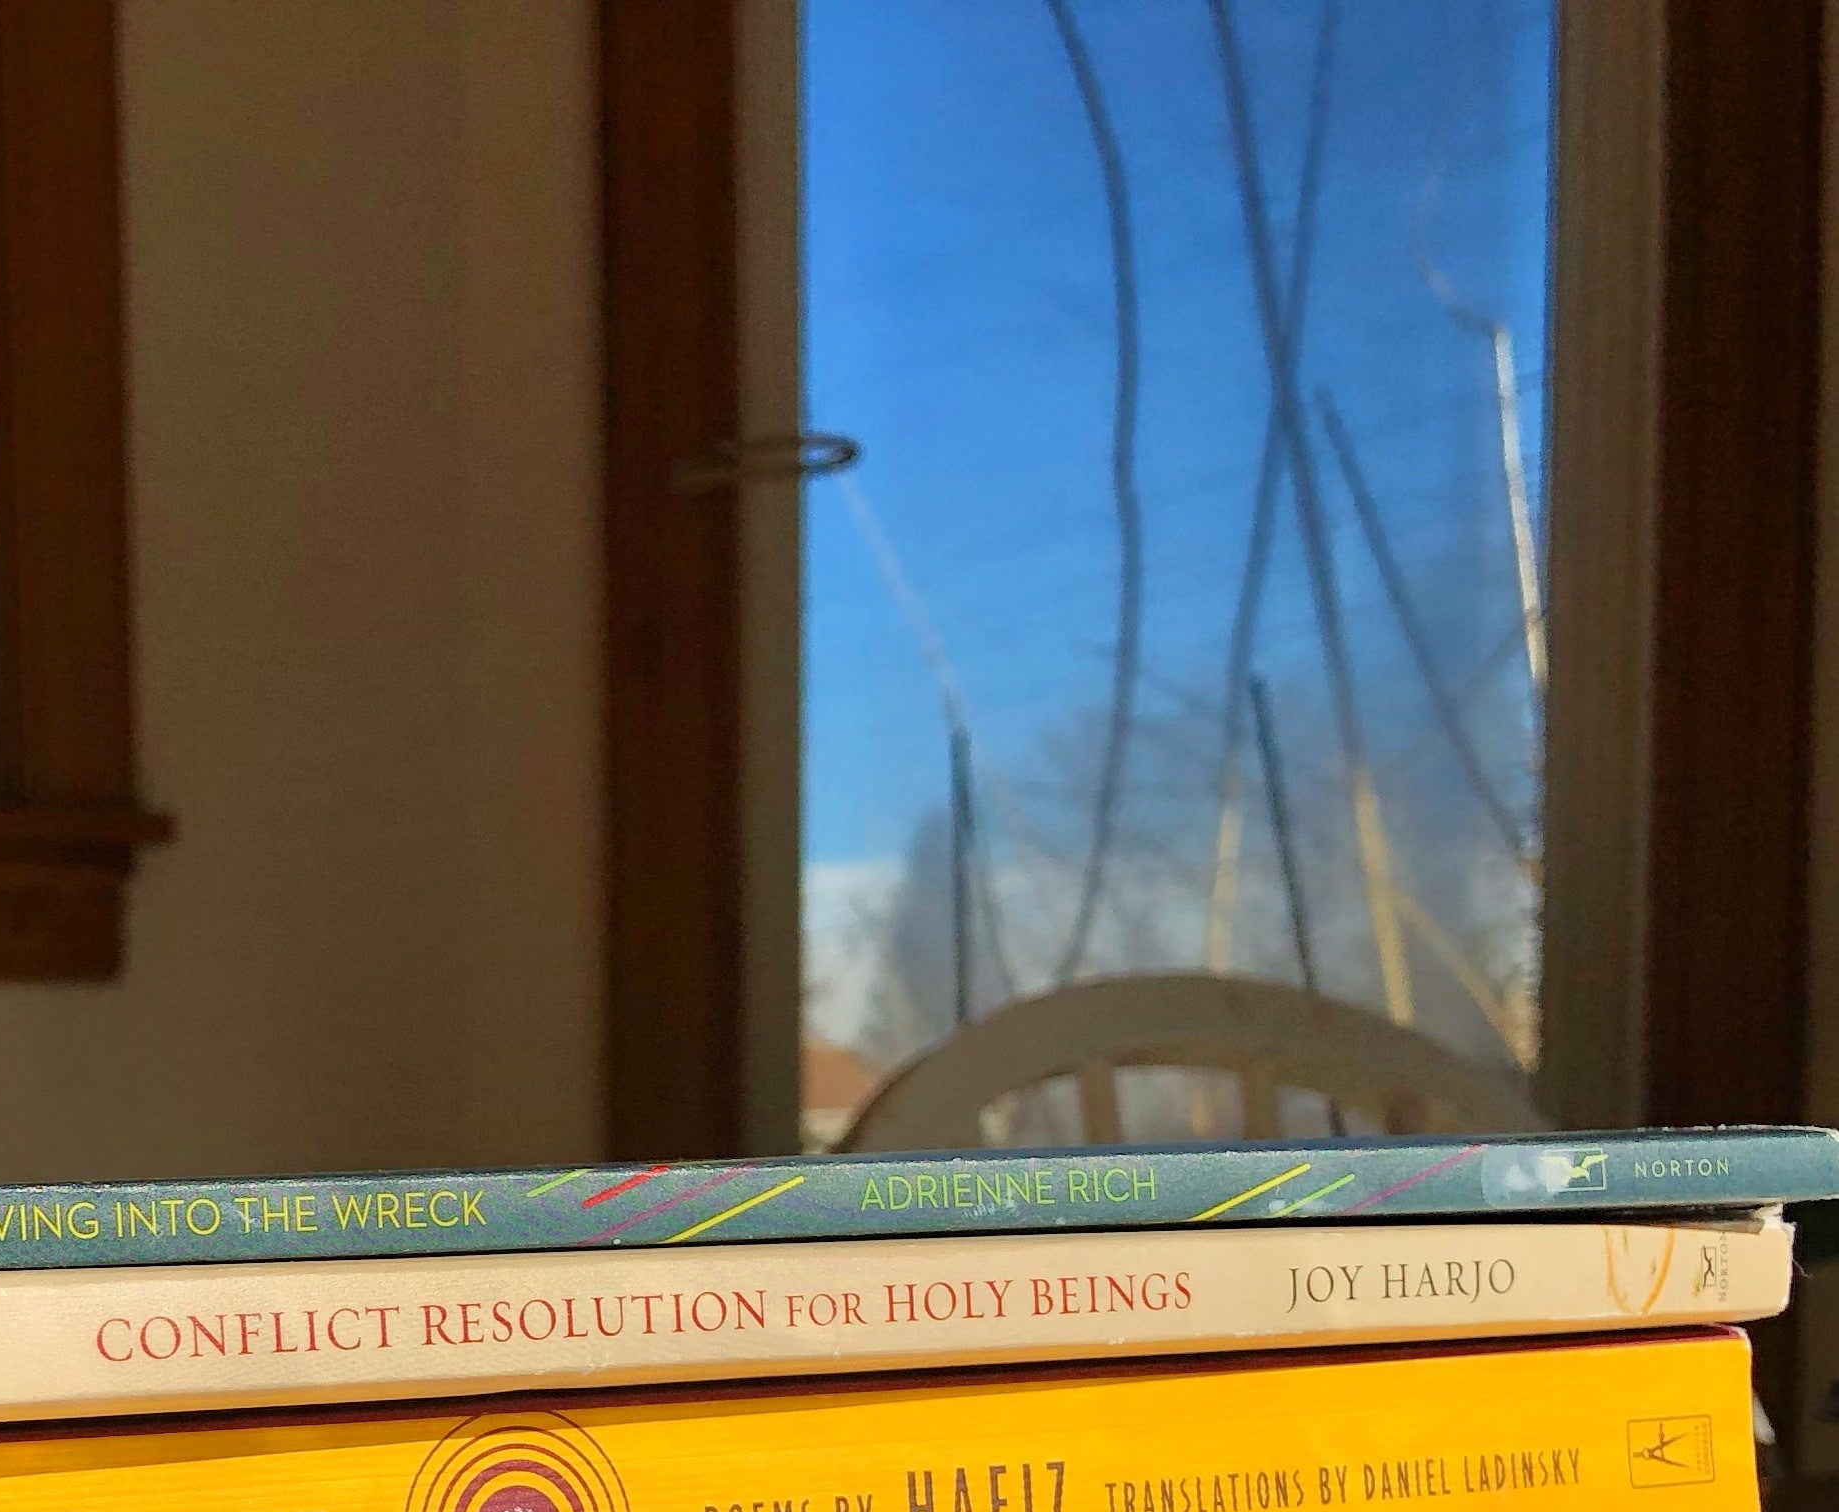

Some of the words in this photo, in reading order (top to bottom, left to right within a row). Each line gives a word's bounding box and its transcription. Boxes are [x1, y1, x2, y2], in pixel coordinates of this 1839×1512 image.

[861, 1170, 1055, 1211] ADRIENNE
[1068, 1167, 1157, 1203] RICH
[1634, 1158, 1729, 1178] NORTON
[117, 1198, 221, 1239] INTO
[234, 1193, 318, 1234] THE
[334, 1189, 487, 1230] WRECK
[1286, 1265, 1364, 1313] JOY
[1381, 1259, 1515, 1304] HARJO
[96, 1306, 400, 1362] CONFLICT
[420, 1290, 767, 1347] RESOLUTION
[787, 1289, 869, 1328] FOR
[883, 1279, 1014, 1324] HOLY
[1030, 1271, 1192, 1316] BEINGS
[1319, 1464, 1351, 1506] BY
[1363, 1456, 1451, 1501] DANIEL
[1463, 1447, 1582, 1493] LADINSKY
